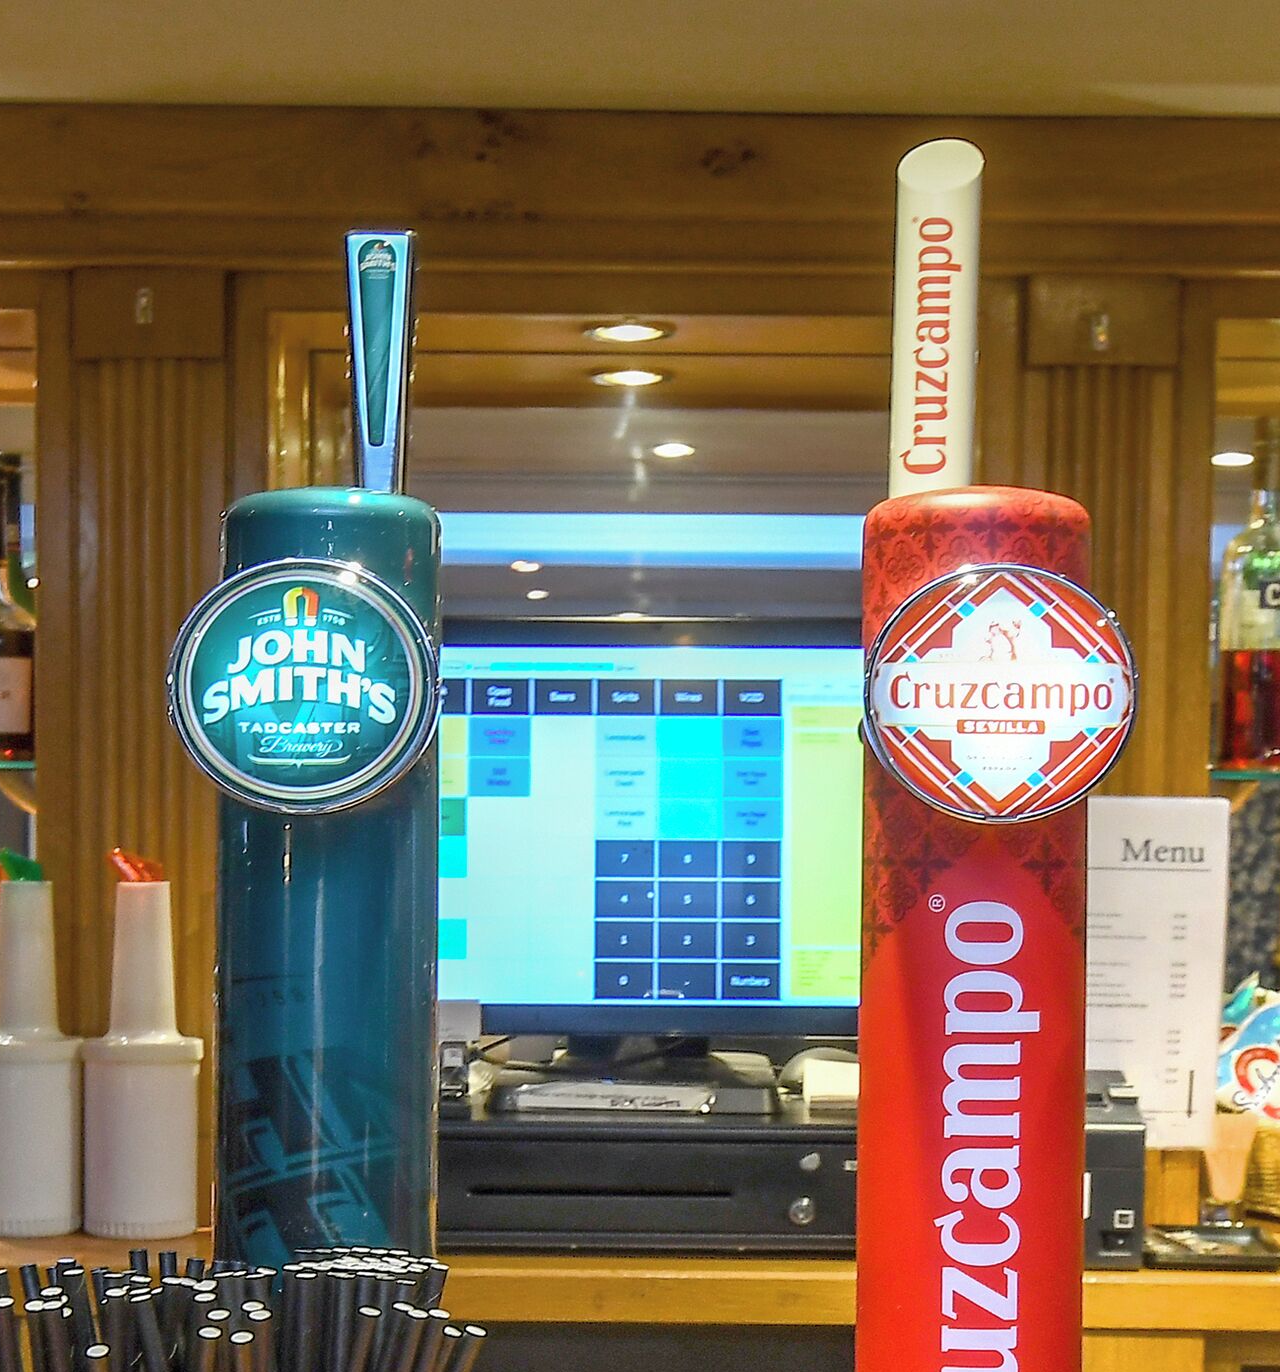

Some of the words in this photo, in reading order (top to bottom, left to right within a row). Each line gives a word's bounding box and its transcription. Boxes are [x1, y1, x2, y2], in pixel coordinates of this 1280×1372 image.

[899, 216, 962, 476] Cruzcampo
[227, 628, 366, 674] JOHN
[202, 665, 397, 725] SMITH'S
[890, 671, 1113, 717] Cruzcampo
[237, 721, 361, 735] TADCASTER
[962, 720, 1039, 733] SEVILLA
[258, 735, 344, 758] Brewery
[1120, 837, 1206, 864] Menu
